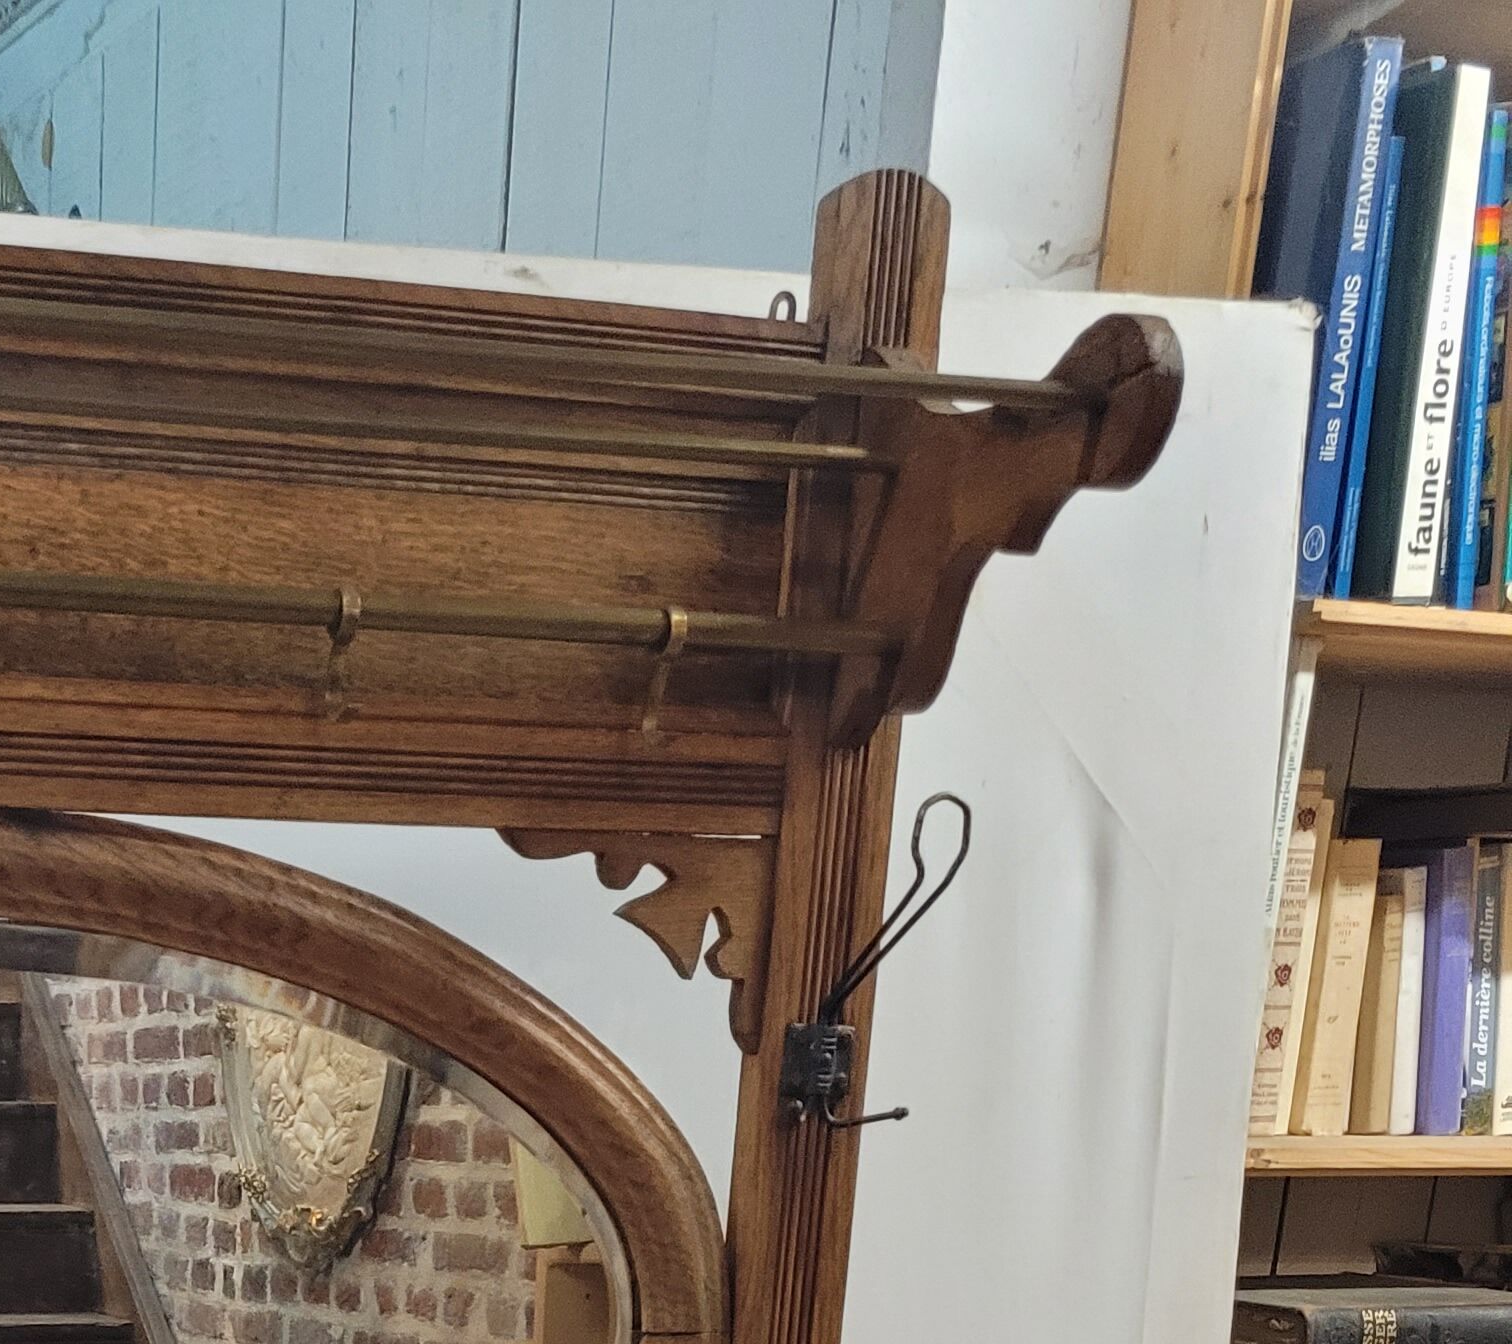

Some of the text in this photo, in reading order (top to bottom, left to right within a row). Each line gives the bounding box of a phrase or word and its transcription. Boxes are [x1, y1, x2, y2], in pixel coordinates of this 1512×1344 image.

[1351, 59, 1391, 251] METAMORPHOSES
[1319, 275, 1362, 462] ilias LALAoUNIS
[1424, 338, 1454, 423] flore
[1408, 457, 1440, 557] faune
[1426, 433, 1435, 451] ET
[1470, 896, 1495, 1088] La dernière colline
